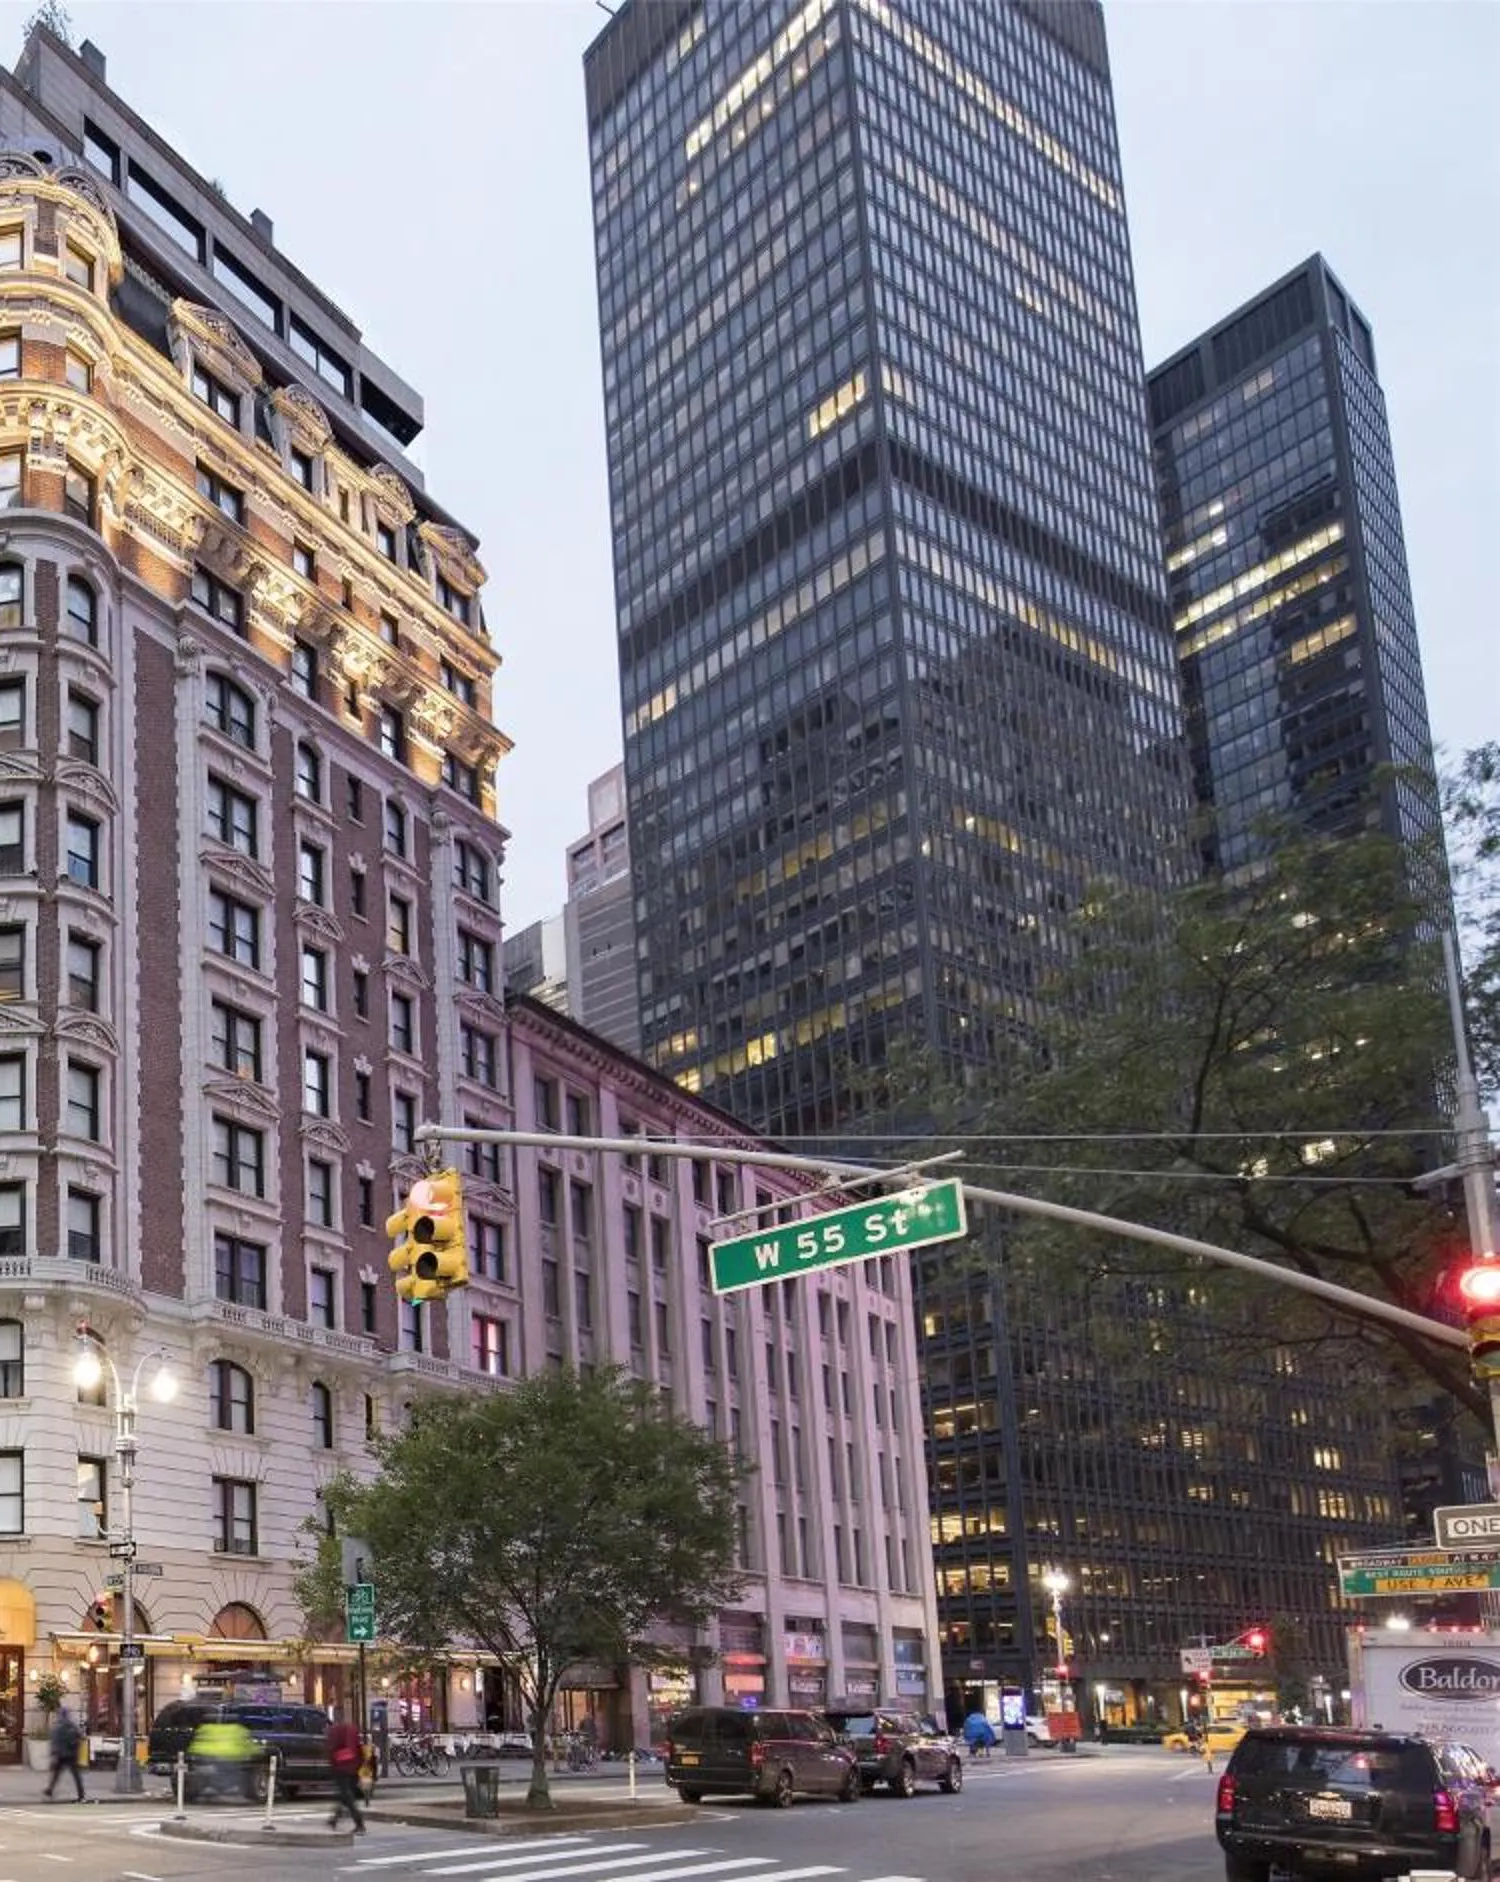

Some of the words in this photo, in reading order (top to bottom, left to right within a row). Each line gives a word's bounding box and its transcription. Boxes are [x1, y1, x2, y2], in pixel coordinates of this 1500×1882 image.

[754, 1241, 780, 1270] W
[796, 1224, 845, 1259] 55
[864, 1209, 910, 1243] St
[1453, 1518, 1500, 1535] ONE
[1443, 1575, 1474, 1587] AVE
[1418, 1667, 1500, 1690] Baldor
